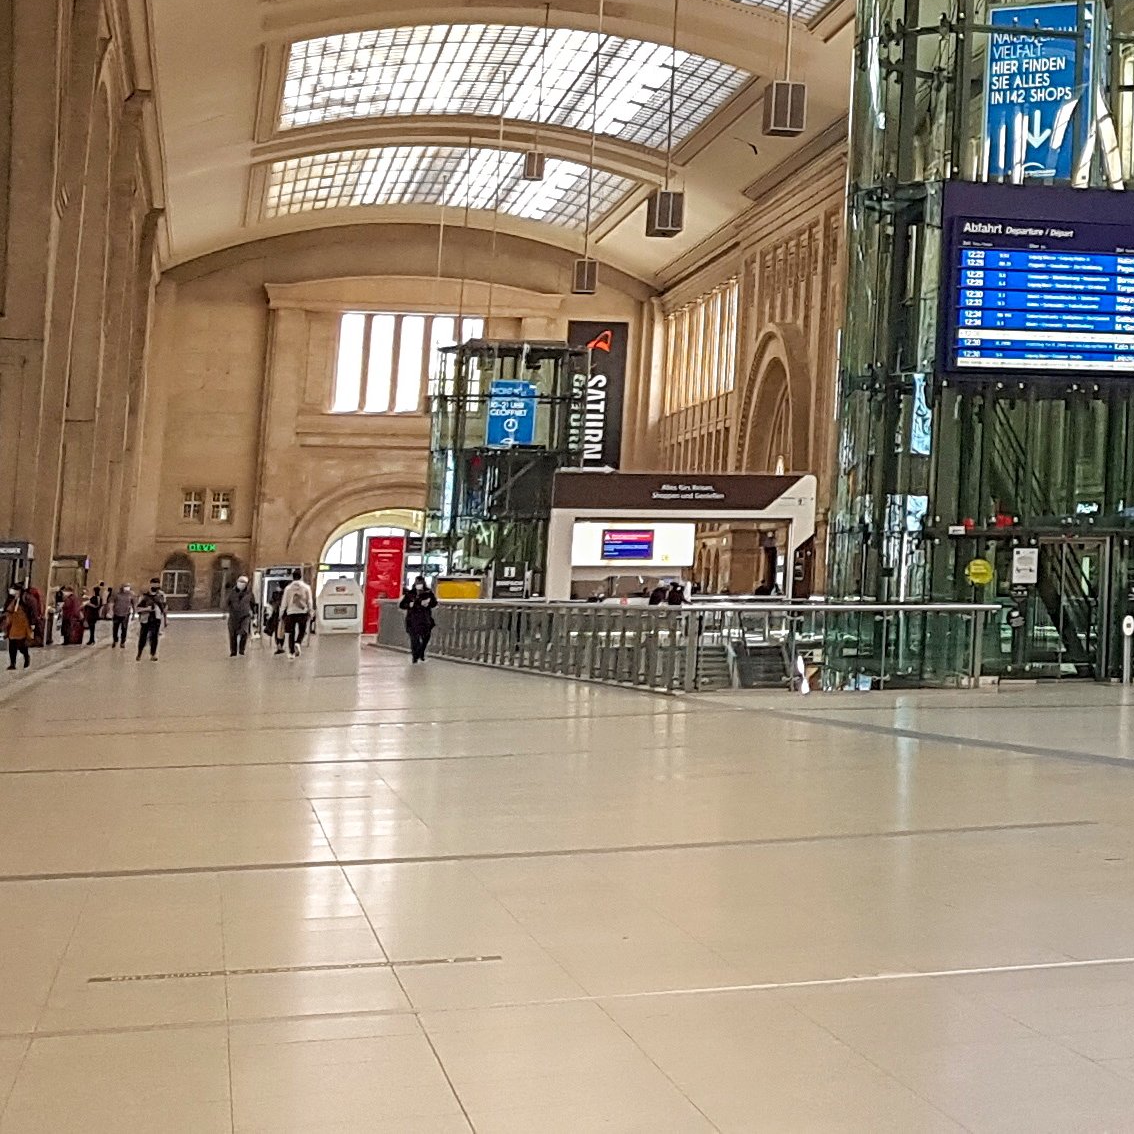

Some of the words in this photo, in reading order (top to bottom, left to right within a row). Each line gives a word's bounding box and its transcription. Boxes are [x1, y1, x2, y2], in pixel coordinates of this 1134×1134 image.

[992, 61, 1018, 74] HIER
[1023, 57, 1065, 71] FINDEN
[992, 76, 1009, 90] SIE
[1014, 73, 1050, 88] ALLES
[992, 91, 1003, 104] IN
[1006, 90, 1025, 103] 142
[1030, 86, 1072, 101] SHOPS
[964, 222, 1002, 234] Abfahrt
[1006, 226, 1043, 236] Departure
[583, 374, 607, 459] SATURN
